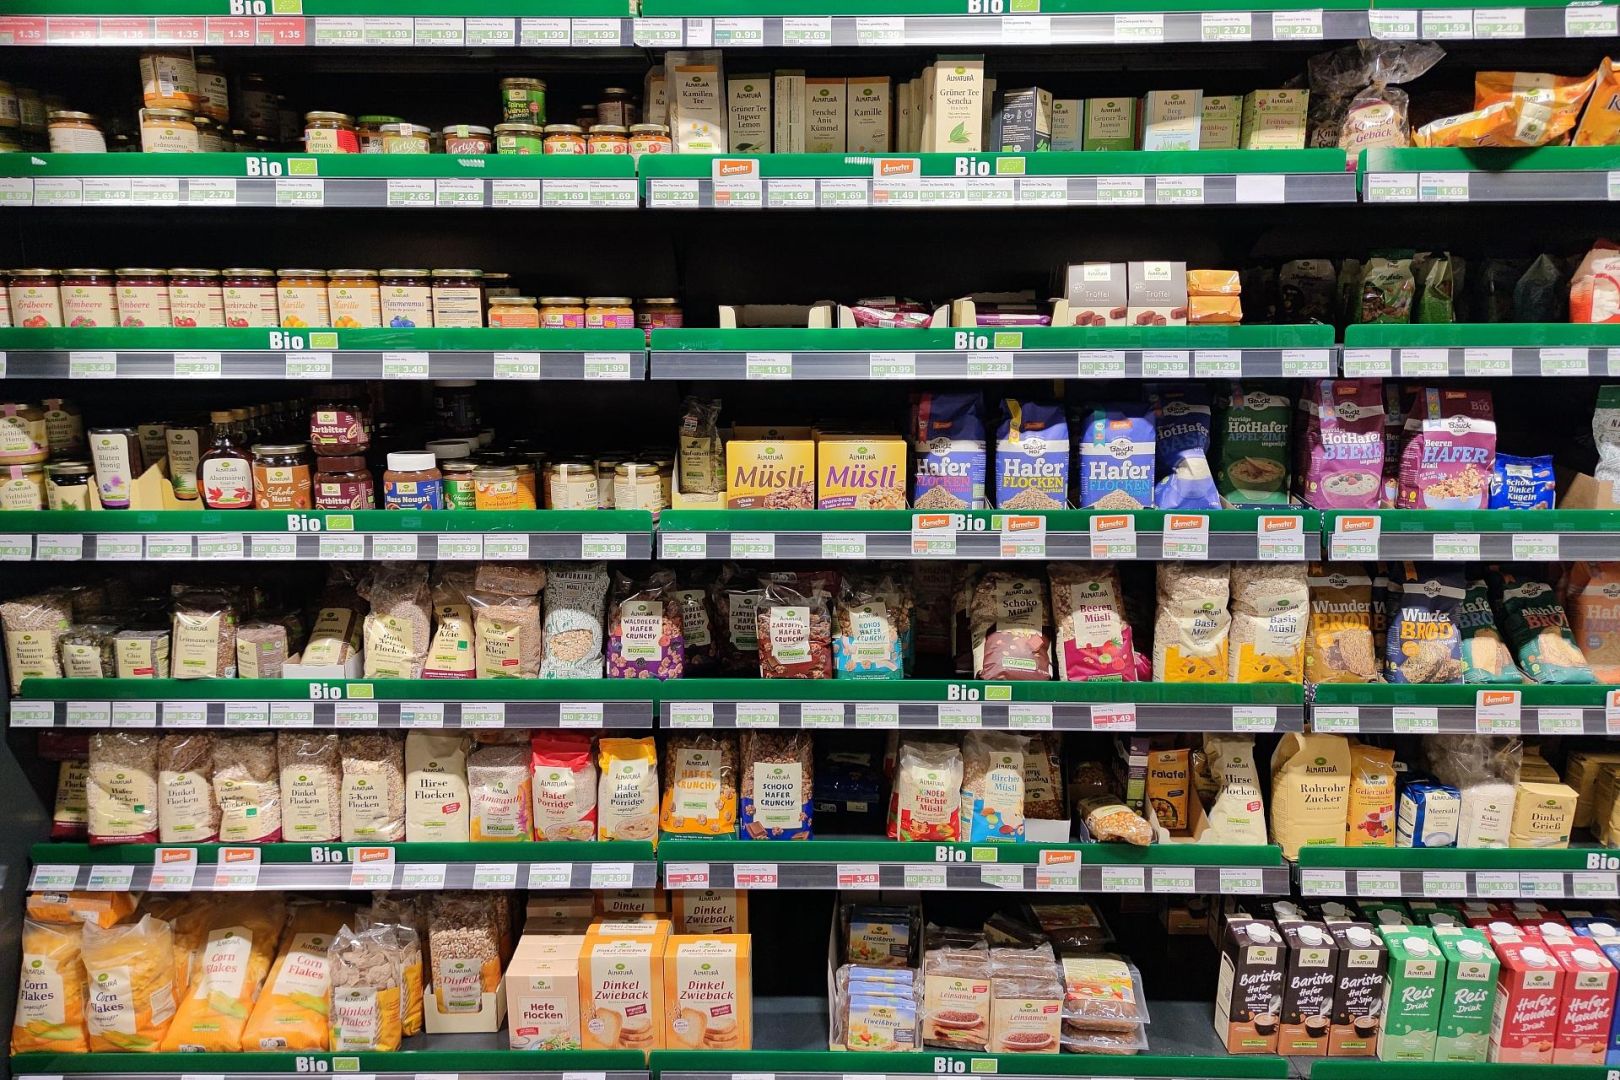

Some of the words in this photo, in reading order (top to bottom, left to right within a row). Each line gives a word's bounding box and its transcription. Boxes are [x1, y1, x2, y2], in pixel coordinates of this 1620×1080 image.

[230, 0, 265, 14] Bio
[968, 0, 1003, 13] Bio
[940, 89, 965, 97] Grüner
[947, 97, 972, 105] Sencha
[731, 105, 754, 113] Grüner
[854, 108, 882, 116] Kamille
[737, 114, 761, 122] Ingwer
[811, 124, 838, 132] Kümmel
[247, 157, 282, 176] Bio
[722, 164, 749, 174] demeter
[883, 163, 911, 173] demeter
[956, 157, 989, 175] Bio
[270, 332, 303, 349] Bio
[955, 332, 987, 349] Bio
[312, 426, 347, 434] Zartbitter
[1423, 447, 1488, 463] HAFER
[917, 459, 970, 476] Hafer
[1004, 458, 1064, 477] Hafer
[1089, 462, 1150, 479] Hafer
[735, 465, 804, 488] Müsli
[826, 465, 897, 488] Müsli
[1003, 477, 1064, 488] FLOCKEN
[267, 487, 296, 497] Schoko
[1509, 485, 1534, 493] Dinkel
[272, 495, 291, 503] Nuss
[402, 495, 430, 504] Nougat
[1507, 493, 1537, 502] Kugeln
[288, 515, 320, 532] Bio
[955, 515, 985, 530] Bio
[1011, 521, 1036, 530] demeter
[1099, 519, 1125, 529] demeter
[1173, 518, 1199, 528] demeter
[1267, 520, 1293, 530] demeter
[1344, 520, 1371, 530] demeter
[1003, 599, 1037, 608] Schoko
[1080, 604, 1111, 612] Beeren
[1312, 600, 1370, 613] Wunder
[1008, 607, 1033, 616] Müsli
[1084, 613, 1110, 623] Müsli
[1270, 615, 1296, 624] Basis
[1195, 619, 1217, 628] Basis
[1268, 623, 1296, 633] Müsli
[310, 683, 341, 699] Bio
[948, 685, 979, 700] Bio
[682, 770, 712, 778] HAFER
[992, 774, 1019, 783] Bircher
[1151, 769, 1186, 779] Falafel
[420, 780, 447, 788] Hirse
[1227, 776, 1252, 784] Hirse
[678, 781, 716, 791] CRUNCHY
[994, 783, 1016, 792] Müsli
[1300, 784, 1345, 793] Rohrohr
[168, 789, 195, 797] Dinkel
[291, 789, 316, 797] Dinkel
[415, 790, 454, 799] Flocken
[614, 791, 640, 799] Dinkel
[537, 799, 573, 808] Porridge
[610, 798, 644, 807] Porridge
[916, 795, 947, 804] Früchte
[1304, 794, 1341, 803] Zucker
[920, 804, 943, 812] Müsli
[1532, 813, 1565, 821] Dinkel
[1533, 821, 1560, 830] Grieß
[311, 847, 342, 862] Bio
[936, 846, 966, 862] Bio
[1048, 855, 1072, 864] demeter
[1587, 853, 1619, 870] Bio
[613, 901, 644, 911] Dinkel
[694, 906, 726, 915] Dinkel
[686, 914, 734, 924] Zwieback
[212, 953, 235, 962] Corn
[297, 955, 322, 967] Corn
[207, 964, 237, 974] Flakes
[288, 965, 323, 979] Flakes
[1240, 970, 1282, 986] Barista
[1291, 973, 1333, 988] Barista
[1340, 974, 1382, 989] Barista
[25, 980, 47, 990] Corn
[602, 981, 639, 989] Dinkel
[688, 981, 724, 989] Dinkel
[1248, 985, 1270, 993] Hafer
[21, 990, 54, 1000] Flakes
[96, 992, 117, 1002] Corn
[595, 991, 648, 1000] Zwieback
[680, 991, 733, 1000] Zwieback
[940, 992, 976, 1000] Leinsamen
[1299, 988, 1323, 996] Hafer
[1348, 988, 1371, 997] Hafer
[1402, 987, 1434, 1002] Reis
[1455, 989, 1488, 1004] Reis
[530, 1003, 554, 1011] Hefe
[1404, 1001, 1428, 1011] Drink
[1517, 995, 1556, 1011] Hafer
[1569, 996, 1609, 1011] Hafer
[339, 1007, 373, 1016] Dinkel
[1456, 1004, 1482, 1013] Drink
[524, 1011, 563, 1020] Flocken
[1512, 1007, 1555, 1023] Mandel
[1565, 1009, 1609, 1024] Mandel
[1520, 1021, 1544, 1032] Drink
[1573, 1022, 1598, 1032] Drink
[296, 1056, 327, 1072] Bio
[934, 1057, 965, 1073] Bio
